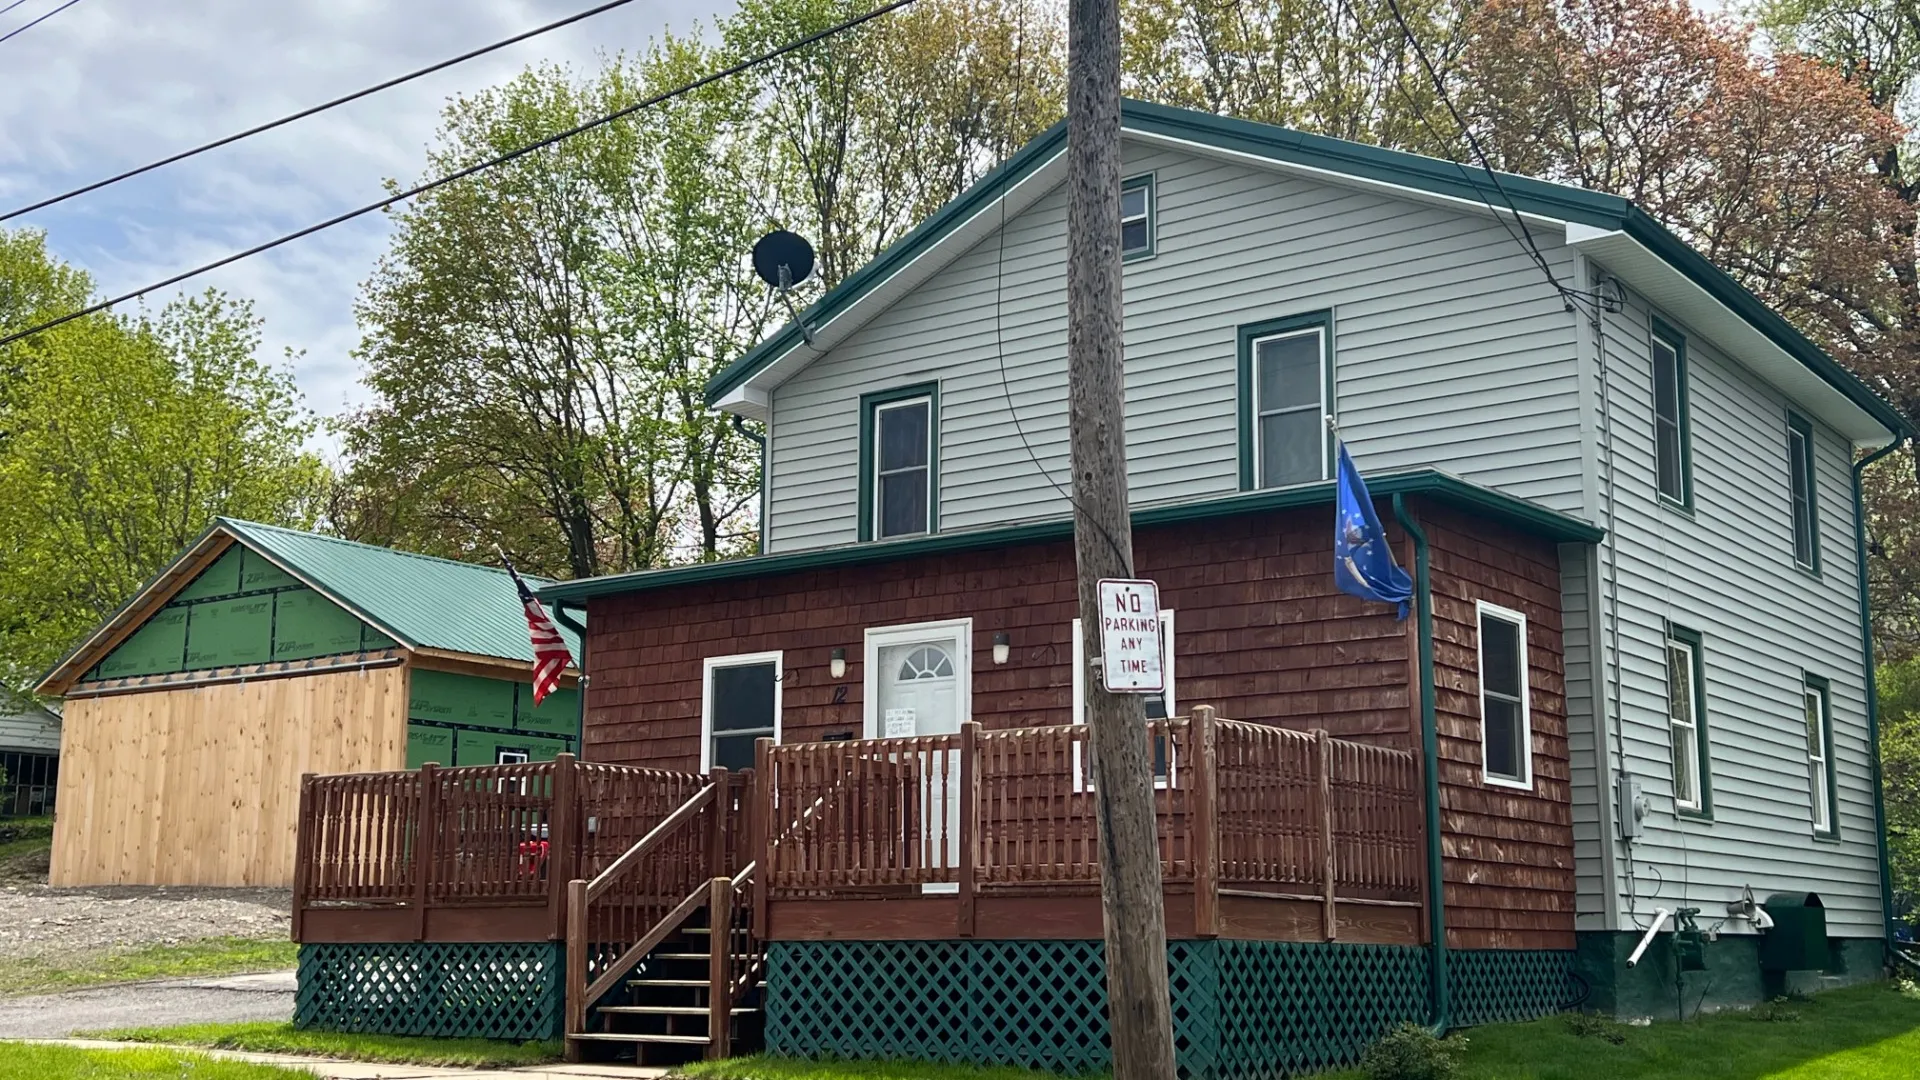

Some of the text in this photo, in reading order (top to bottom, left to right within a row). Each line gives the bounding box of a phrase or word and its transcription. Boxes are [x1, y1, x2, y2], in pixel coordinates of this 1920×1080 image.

[1116, 593, 1141, 612] NO
[1105, 617, 1155, 632] PARKING
[1121, 637, 1142, 650] ANY
[1121, 660, 1147, 673] TIME
[833, 686, 847, 703] 12
